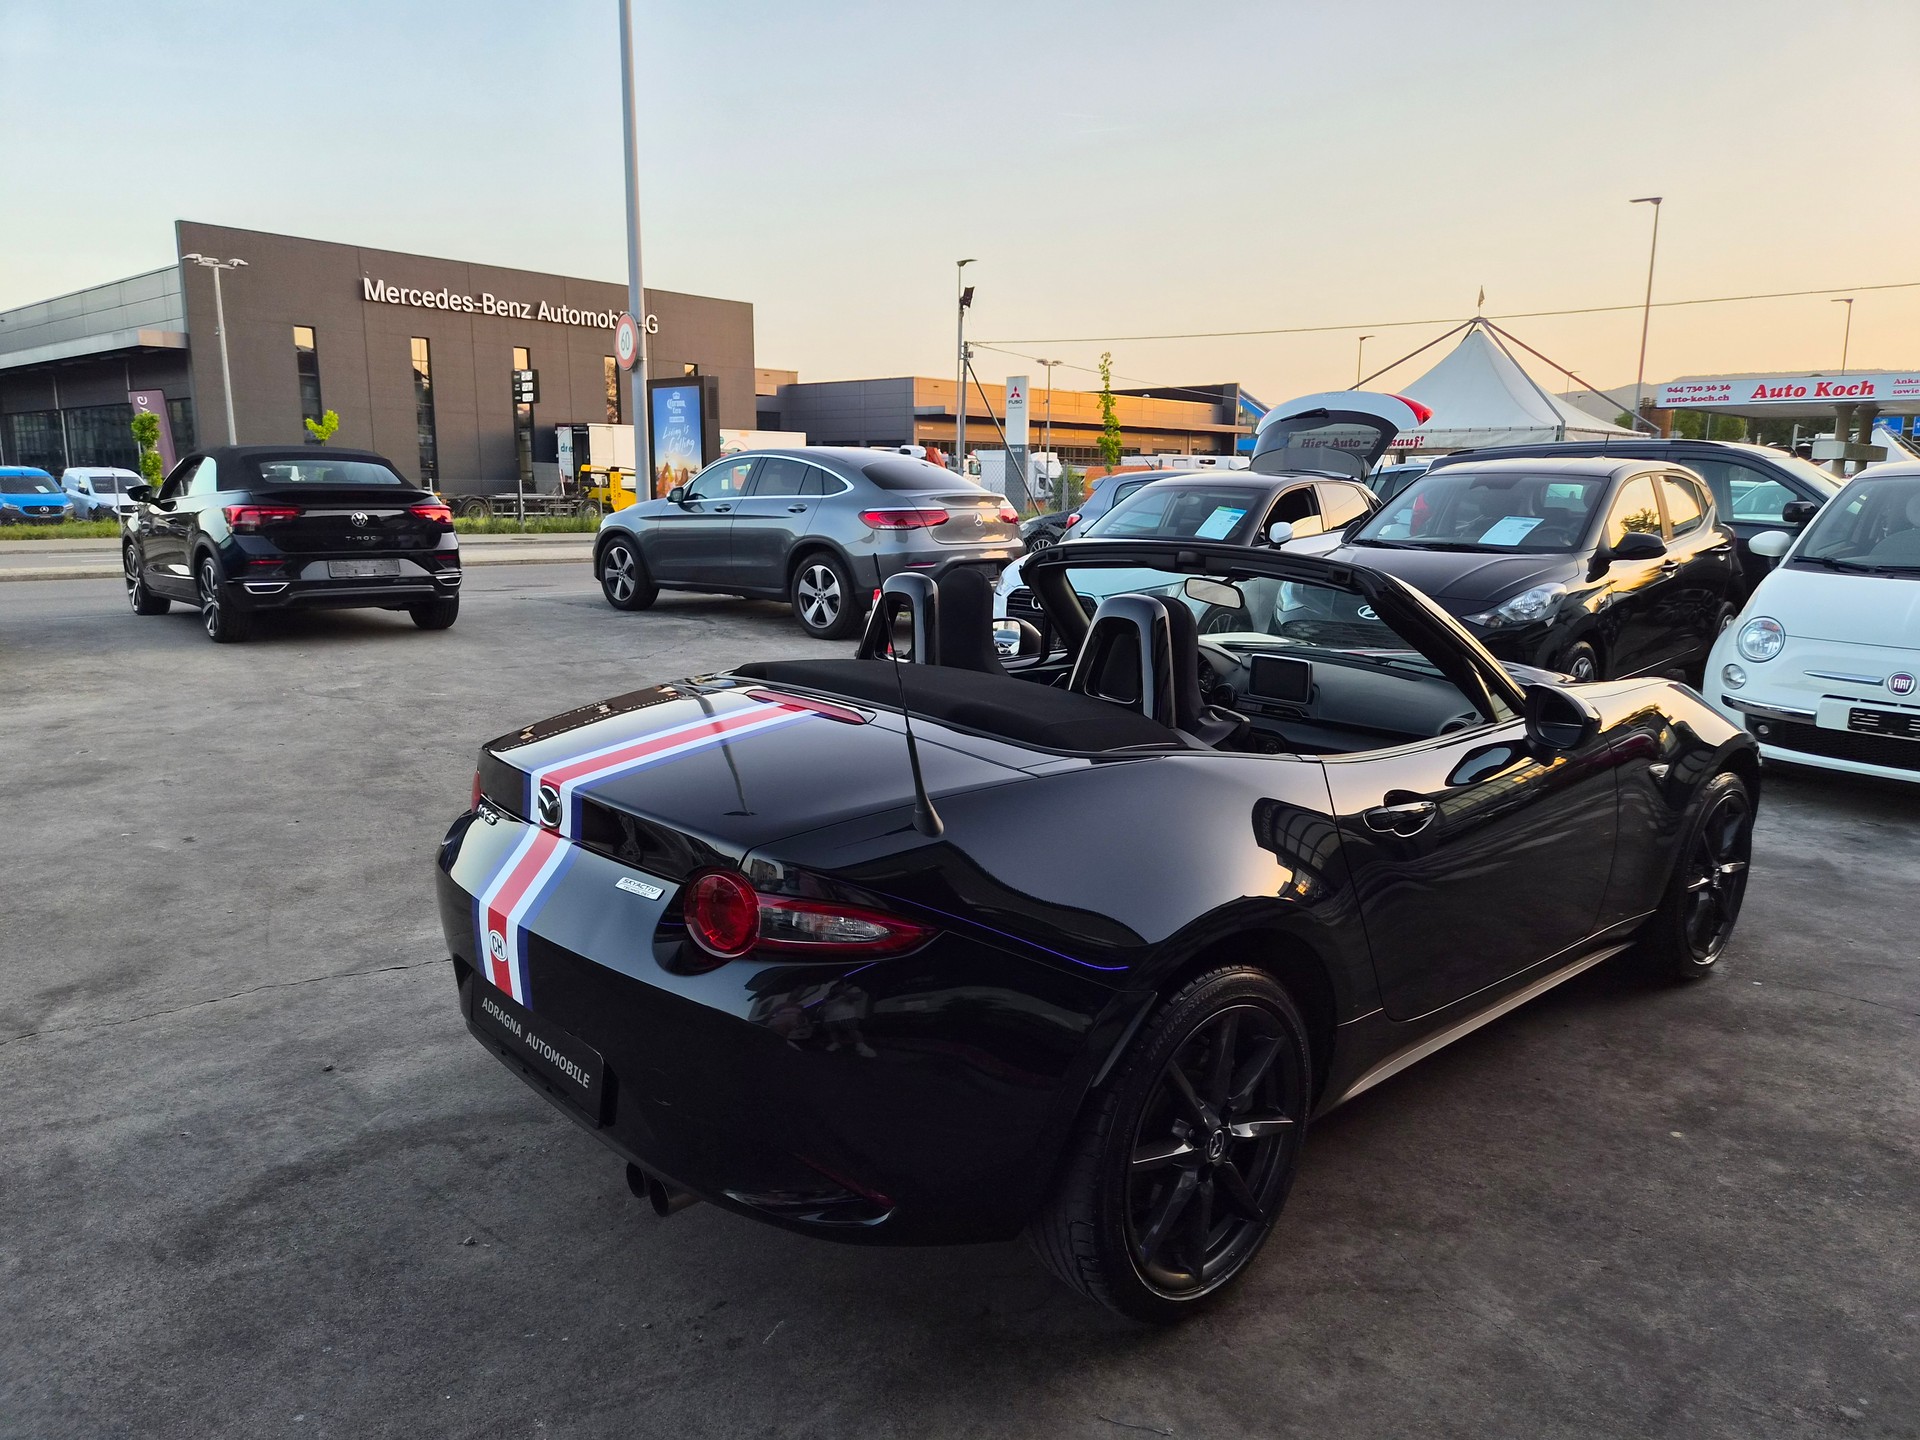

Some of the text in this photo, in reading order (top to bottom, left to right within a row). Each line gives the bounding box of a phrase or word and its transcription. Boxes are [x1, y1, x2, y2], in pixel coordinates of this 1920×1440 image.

[363, 277, 659, 335] Mercedes-Benz Automob G
[620, 331, 631, 352] 60
[1686, 385, 1703, 393] 730
[1705, 384, 1717, 392] 36
[1719, 384, 1731, 392] 36
[1751, 380, 1875, 399] Auto Koch
[1666, 394, 1730, 403] auto-koch.ch
[1300, 438, 1328, 449] Hier
[1893, 678, 1912, 690] FIAT
[622, 878, 659, 893] SKYACTIV
[491, 935, 504, 958] CH
[481, 997, 591, 1089] ADRAGNA AUTOMOBILE
